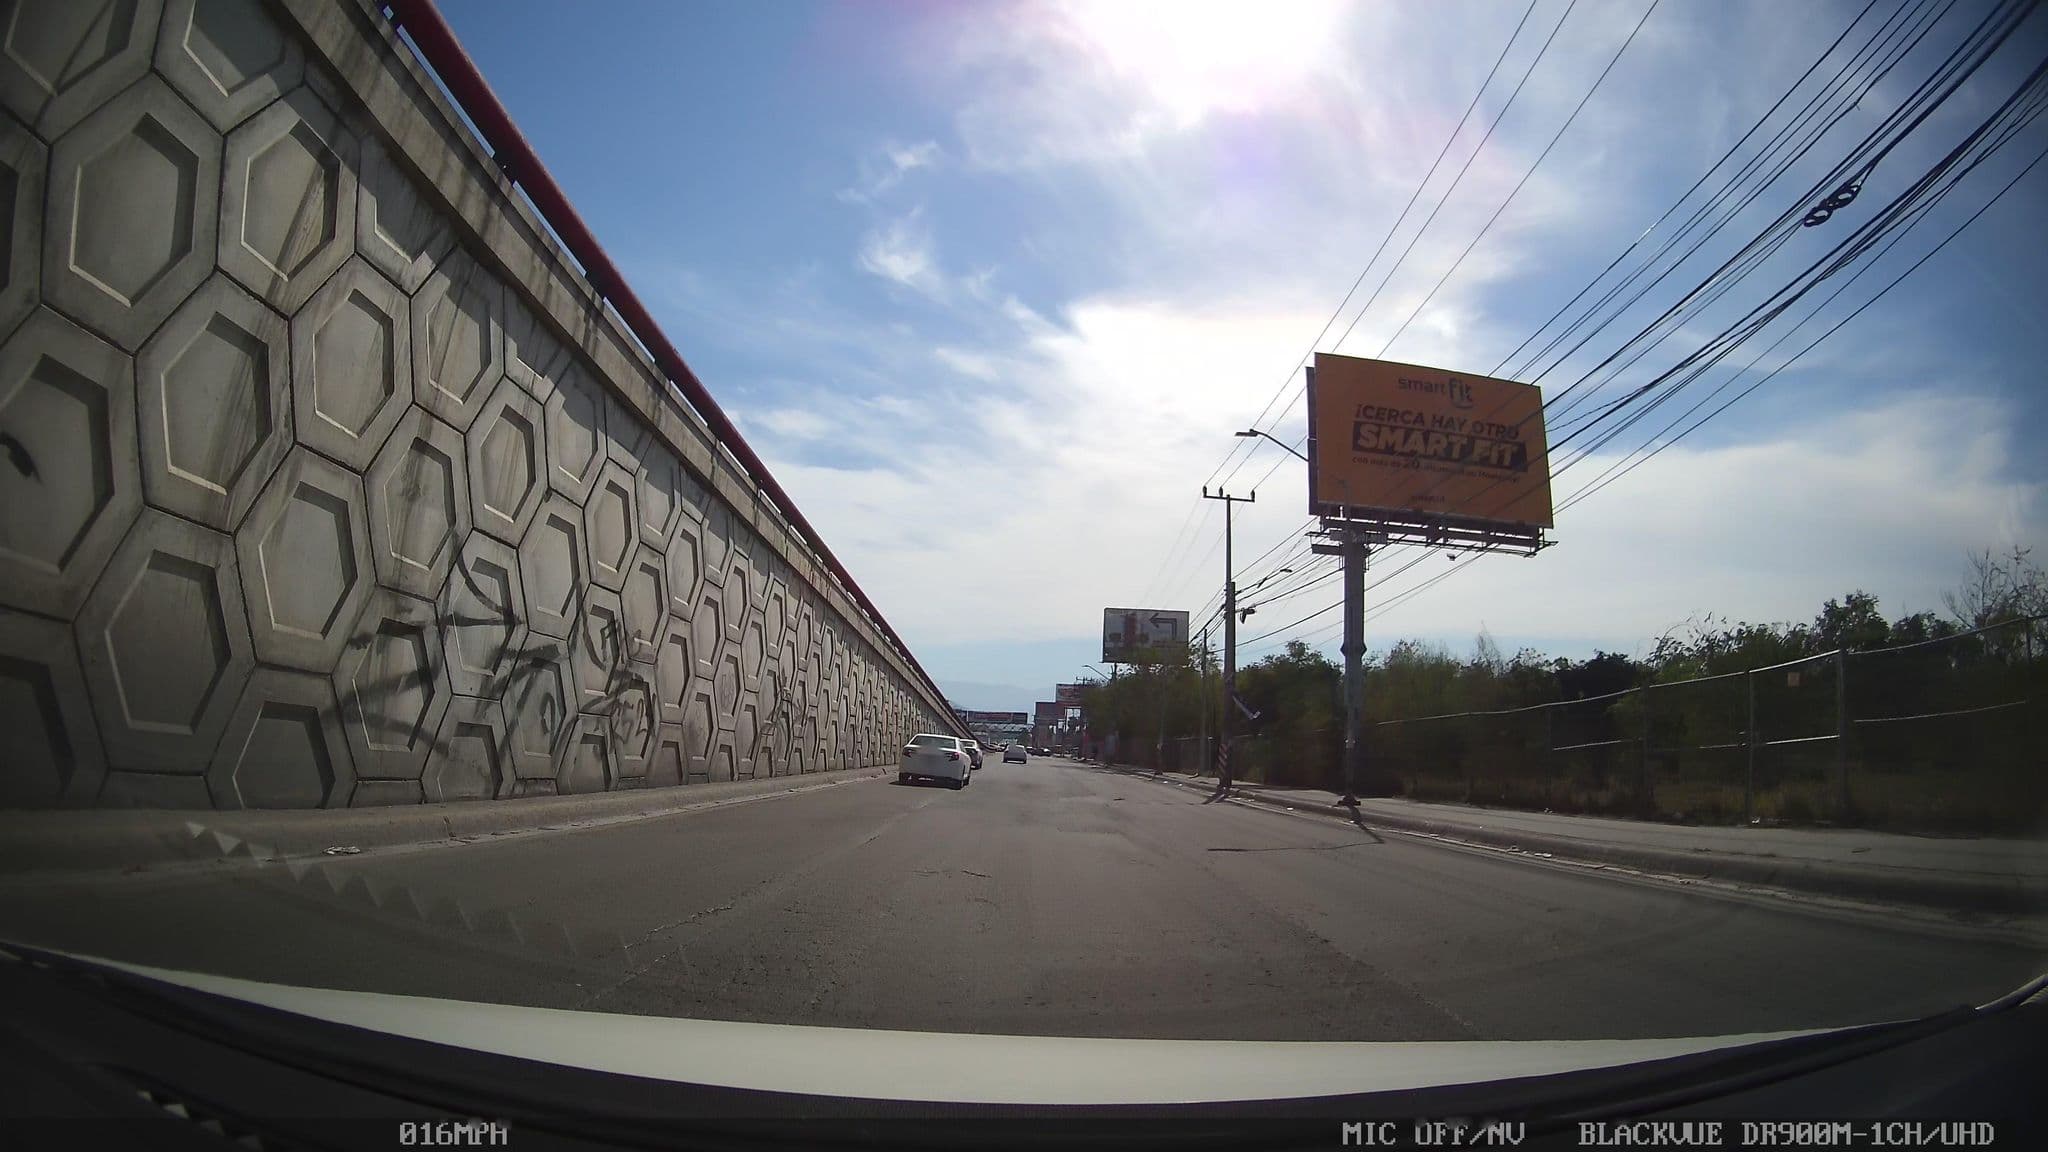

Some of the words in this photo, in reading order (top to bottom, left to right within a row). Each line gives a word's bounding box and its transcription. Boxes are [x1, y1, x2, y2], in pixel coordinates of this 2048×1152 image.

[1398, 378, 1446, 394] smart
[1448, 377, 1474, 408] fit
[1354, 403, 1425, 427] ¡CERCA
[1431, 414, 1468, 432] HAY
[1472, 421, 1519, 439] OTRO
[1357, 424, 1469, 459] SMART
[1474, 441, 1516, 466] FIT
